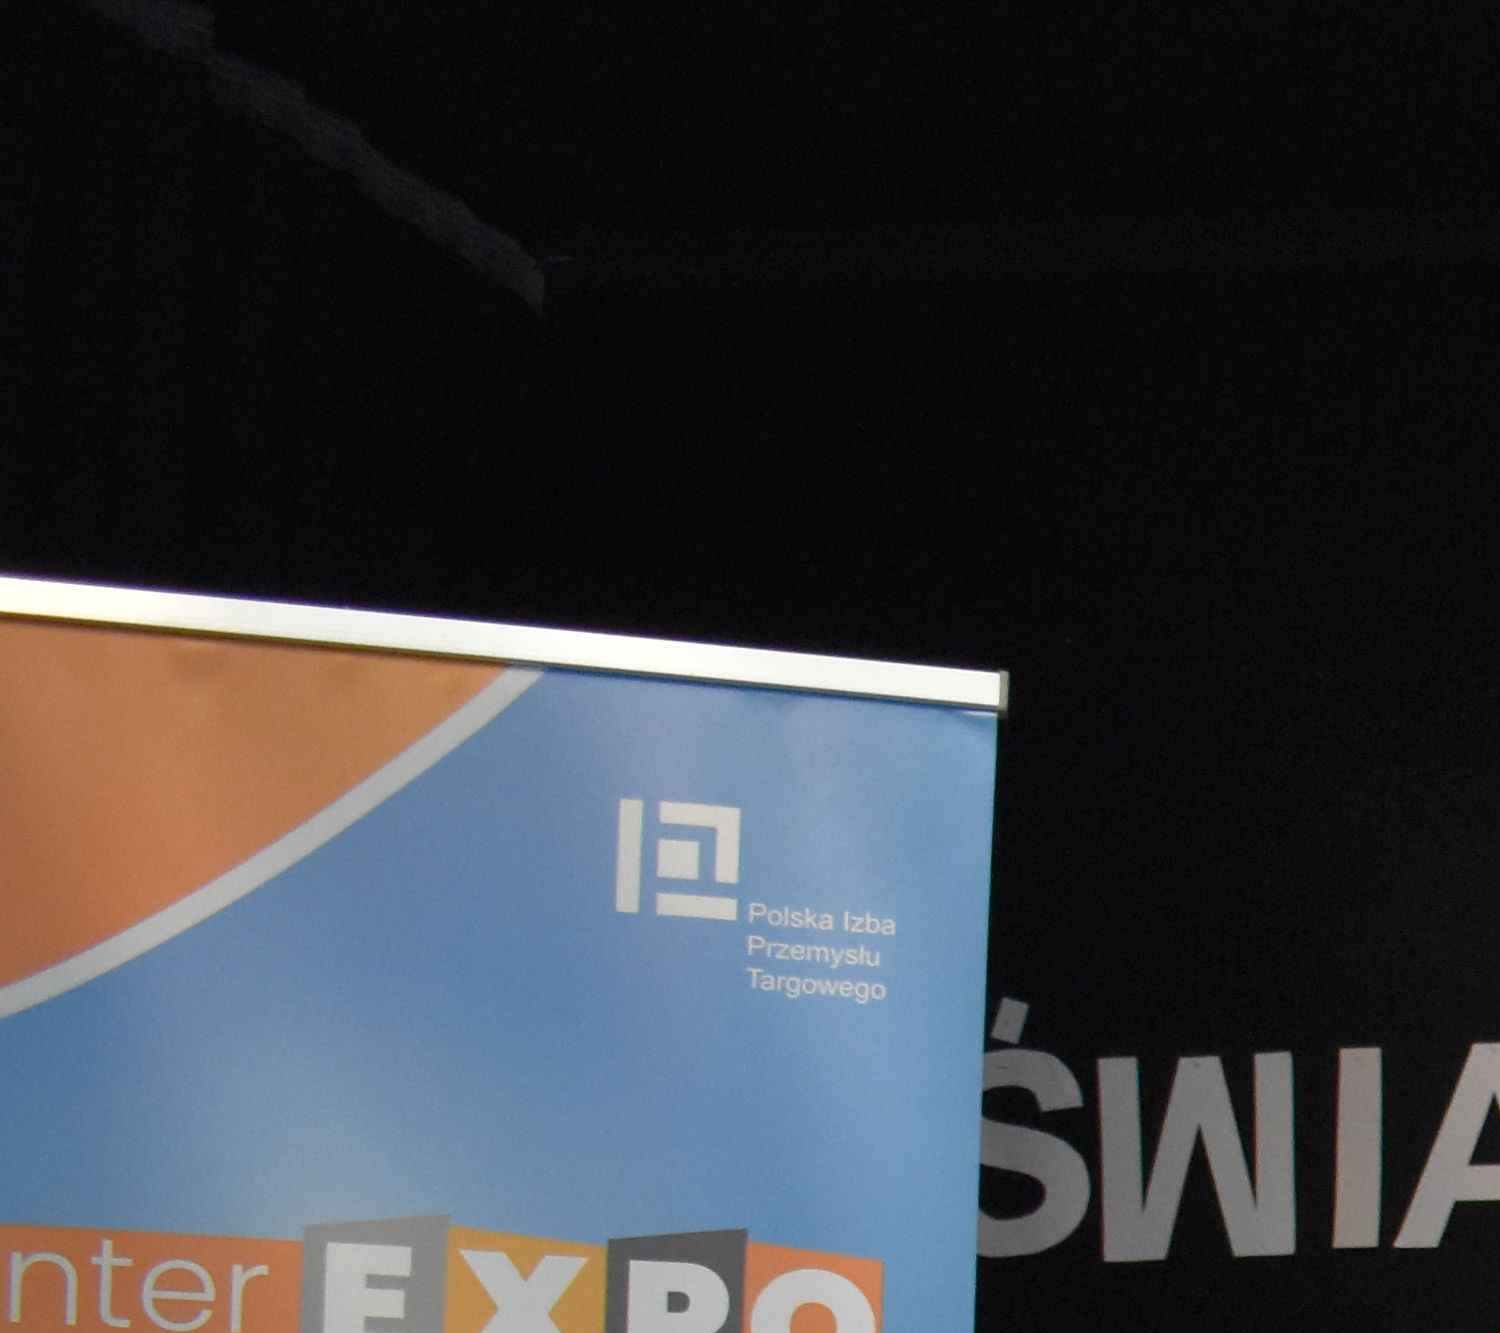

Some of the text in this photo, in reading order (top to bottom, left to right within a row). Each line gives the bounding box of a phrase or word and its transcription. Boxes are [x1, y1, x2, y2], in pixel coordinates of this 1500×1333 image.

[748, 902, 896, 936] Polska Izba
[746, 935, 882, 970] Przemysłu
[746, 968, 887, 1003] Targowego
